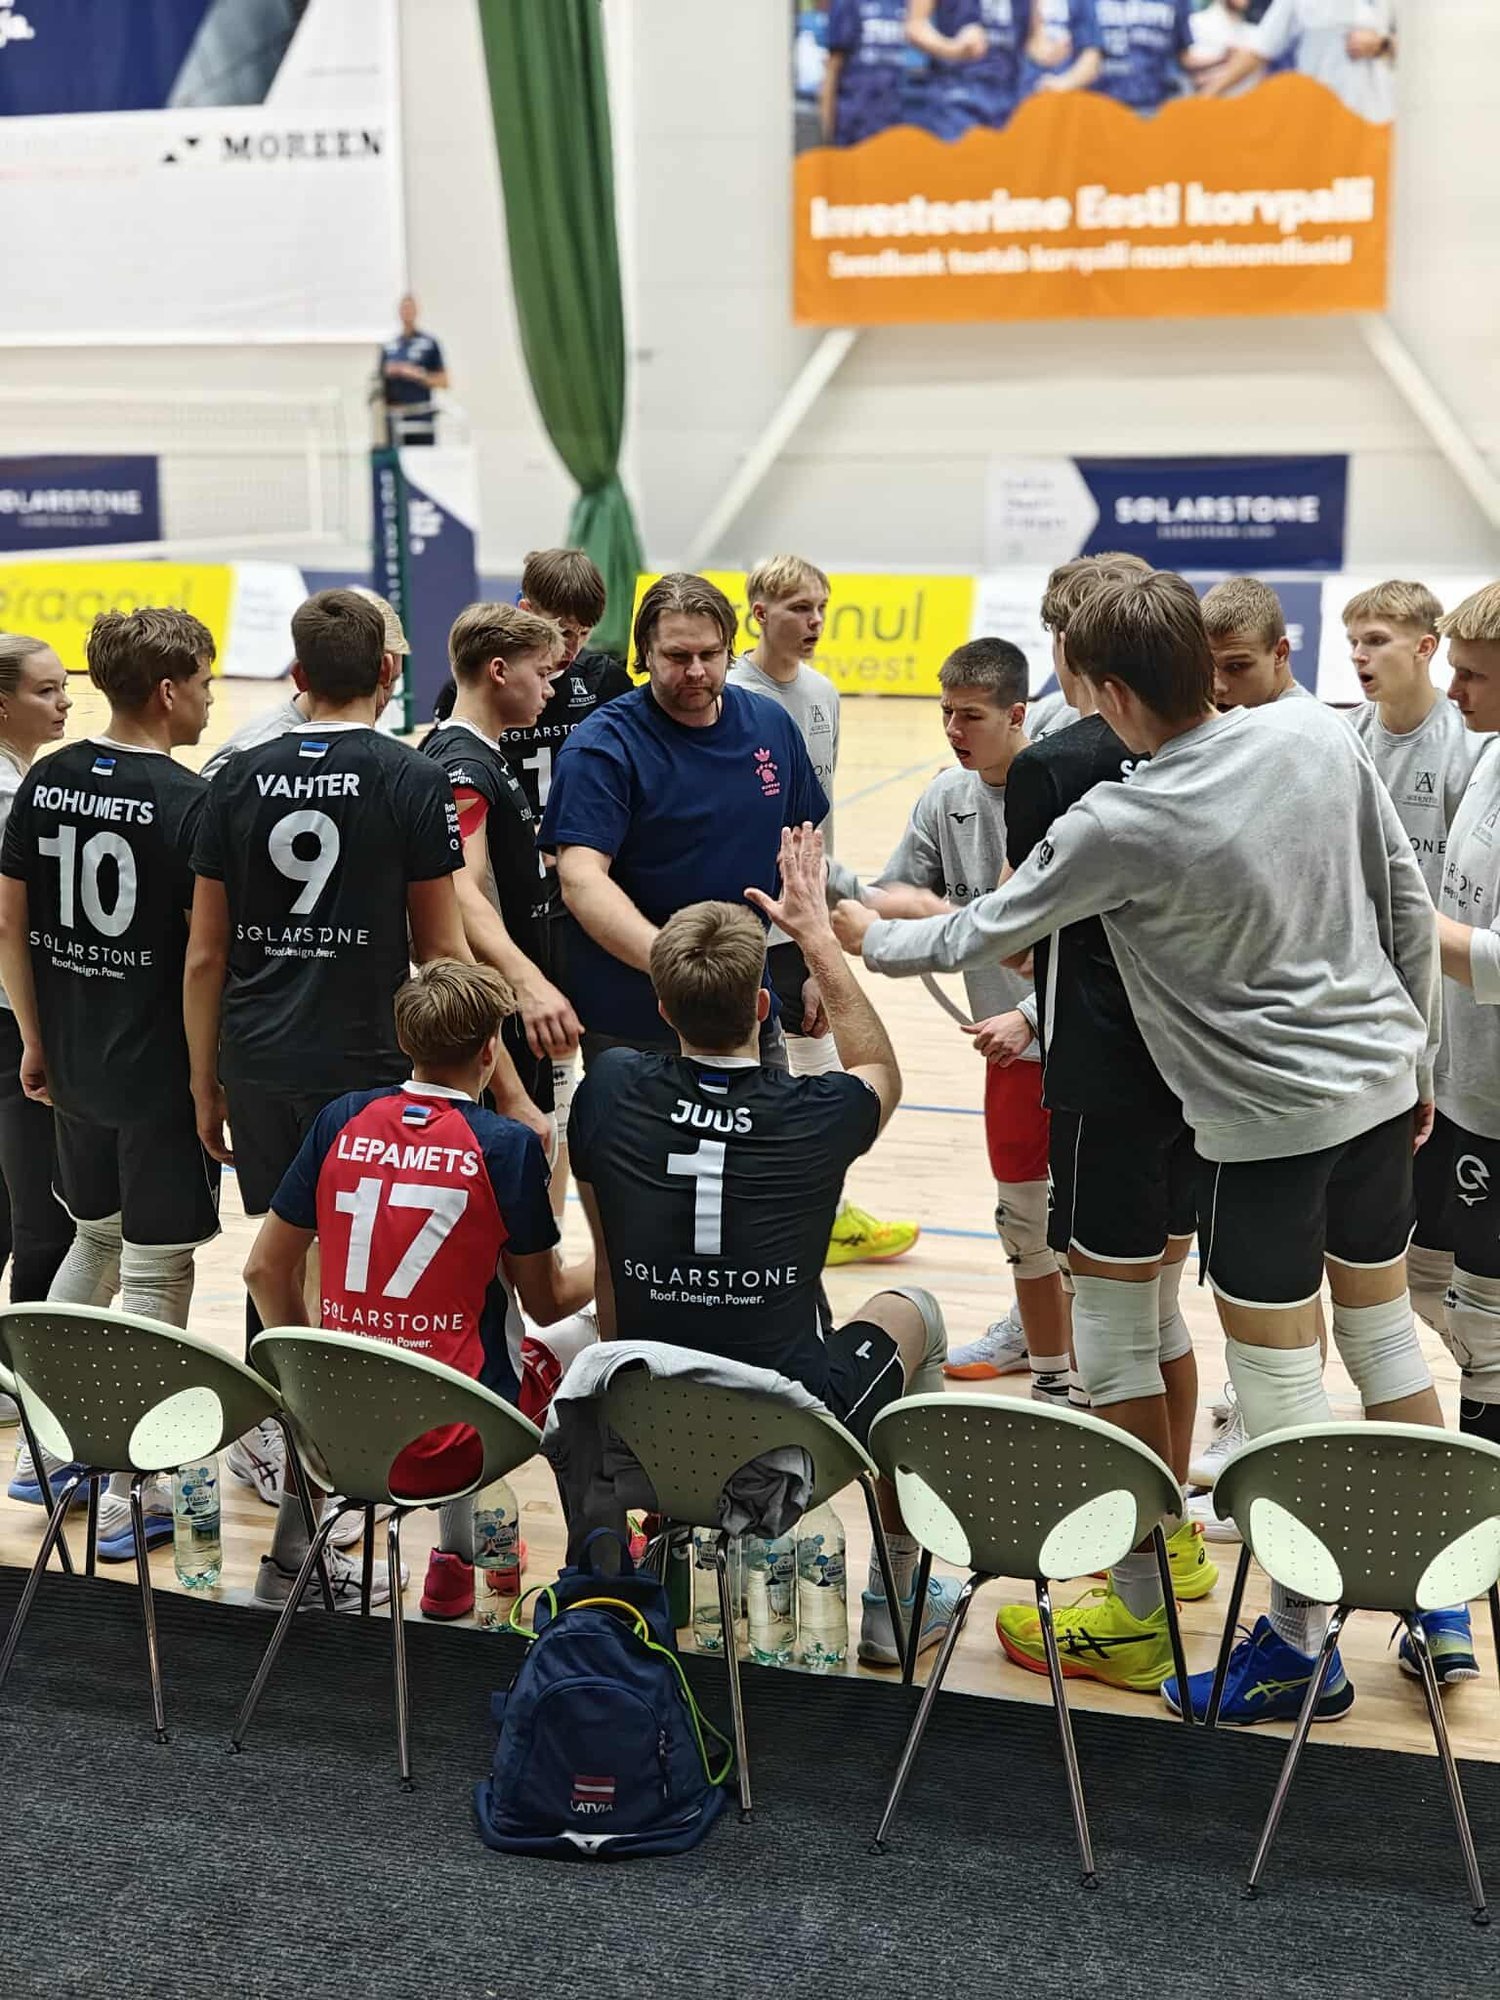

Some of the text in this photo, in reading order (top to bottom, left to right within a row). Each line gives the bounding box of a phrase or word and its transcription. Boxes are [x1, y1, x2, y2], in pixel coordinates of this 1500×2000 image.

[810, 176, 1374, 239] Investeerime Eesti korvpalli
[1115, 495, 1320, 524] SOLARSTONE
[32, 784, 155, 825] ROHUMETS
[256, 773, 361, 799] VAHTER
[38, 824, 137, 937] 10
[268, 809, 341, 914] 9
[670, 1098, 753, 1134] JUUS
[336, 1134, 480, 1177] LEPAMETS
[666, 1138, 726, 1255] 1
[335, 1176, 469, 1299] 17
[570, 1800, 614, 1813] LATVIA
